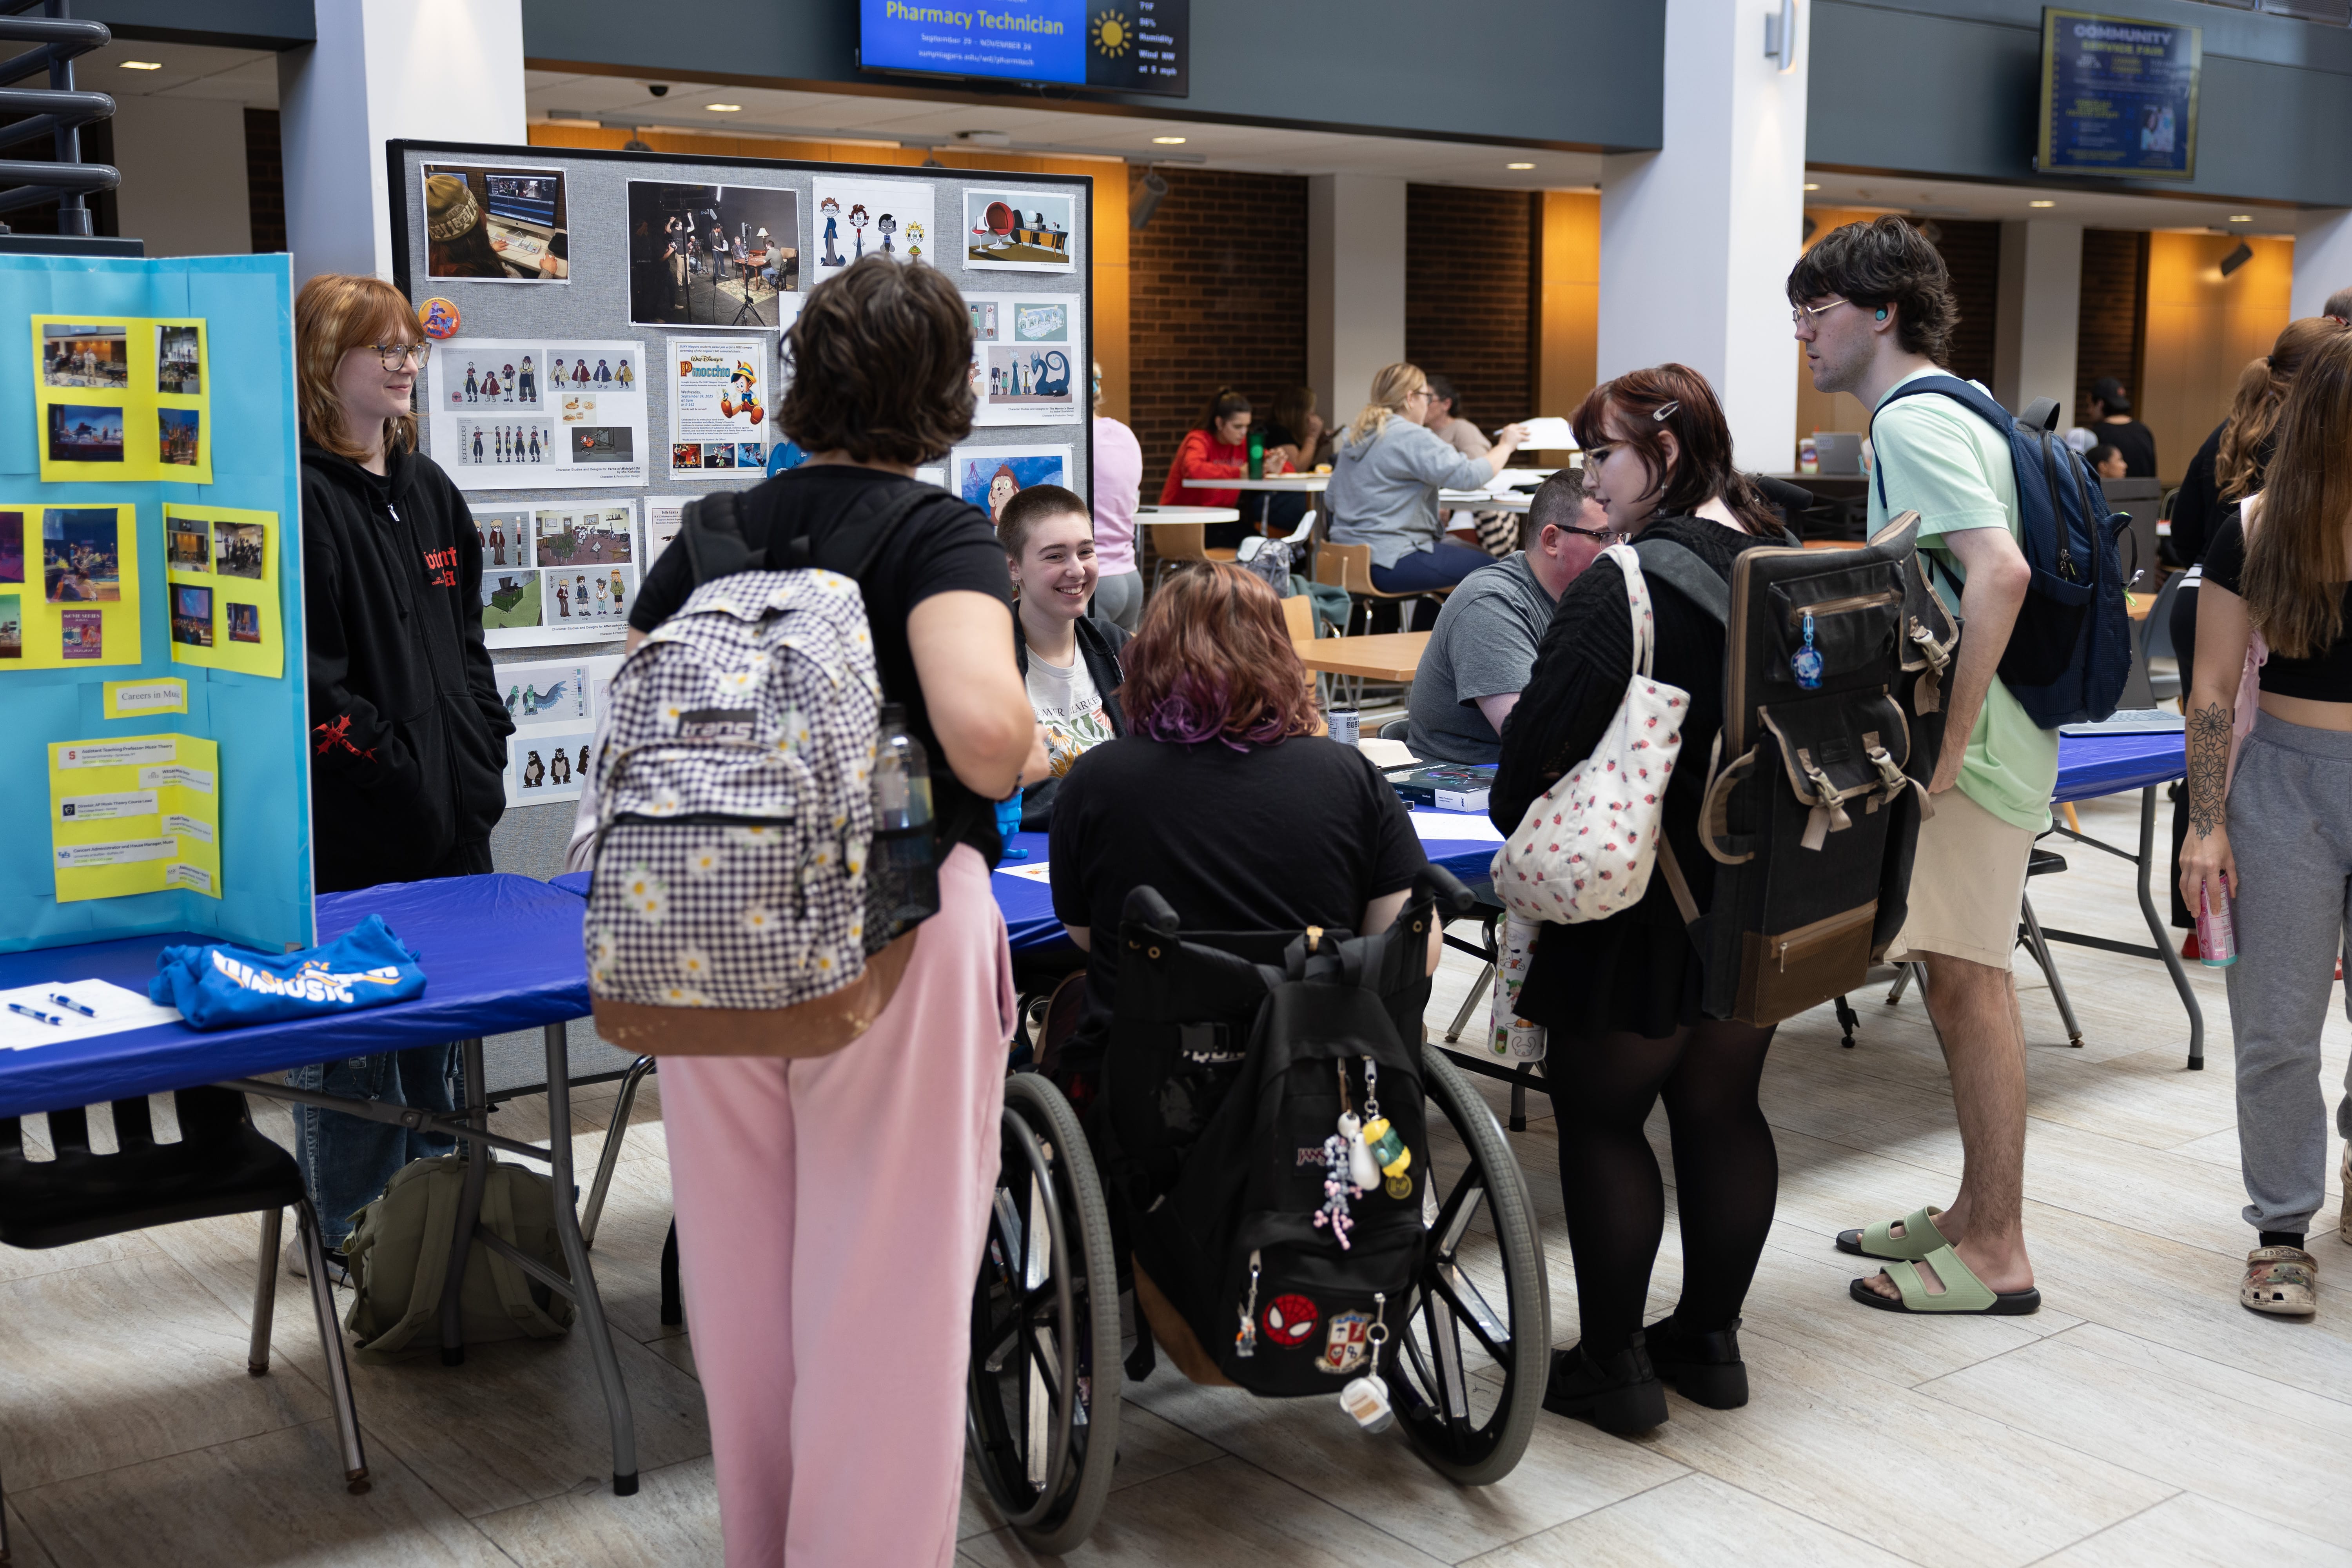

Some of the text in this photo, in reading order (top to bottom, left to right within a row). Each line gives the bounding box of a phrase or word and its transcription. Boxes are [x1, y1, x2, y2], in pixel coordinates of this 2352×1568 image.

[886, 0, 1063, 35] Pharmacy Technician
[1139, 32, 1174, 45] Humidity
[2073, 24, 2172, 45] COMMUNITY
[1138, 49, 1158, 60] Wind
[2136, 45, 2165, 57] FAIR
[1138, 65, 1148, 73] at
[1160, 67, 1177, 77] mph
[680, 361, 730, 377] Pinocchio
[252, 975, 353, 1003] MUSIC
[1296, 1147, 1326, 1166] JANS
